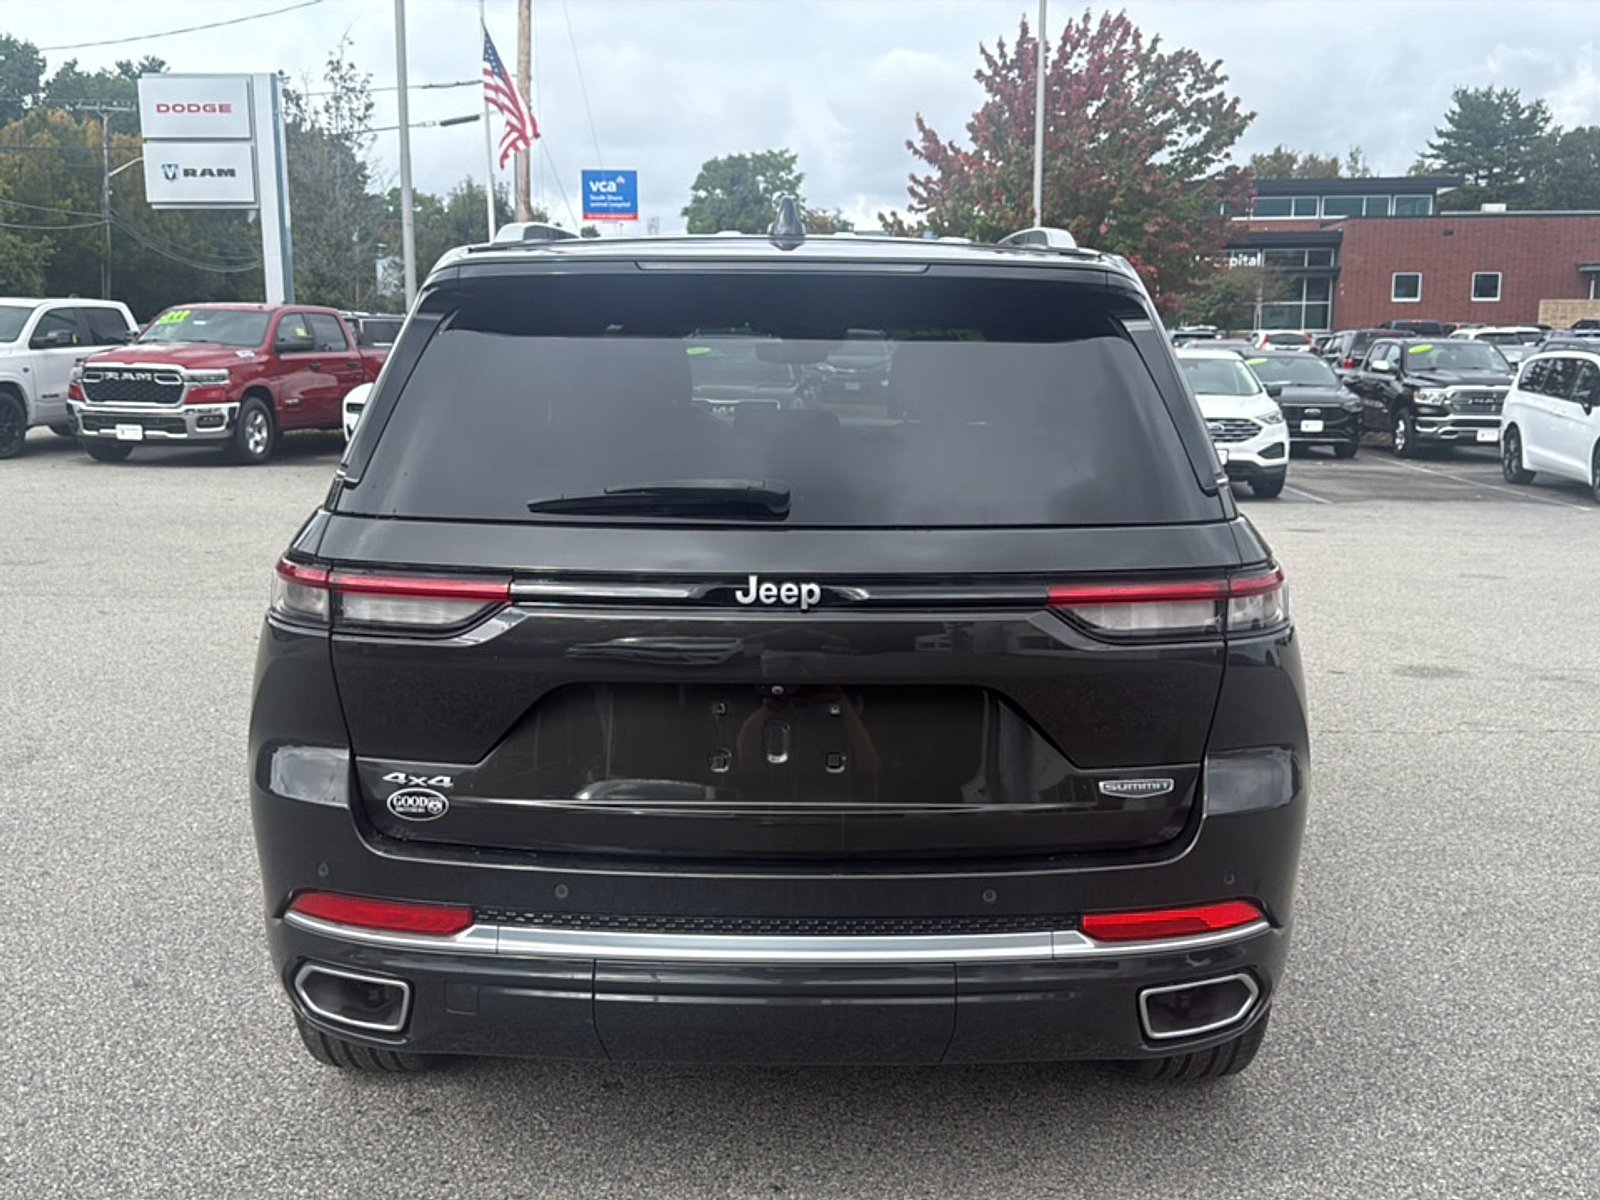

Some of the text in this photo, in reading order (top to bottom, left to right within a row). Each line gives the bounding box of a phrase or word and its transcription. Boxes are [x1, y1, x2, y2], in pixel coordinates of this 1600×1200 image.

[156, 103, 233, 114] DODGE
[183, 168, 236, 177] RAM
[589, 180, 617, 193] vca
[104, 371, 152, 382] RAM
[735, 574, 821, 610] Jeep
[382, 771, 454, 788] 4x4
[1104, 781, 1169, 791] SUMMIT
[393, 795, 428, 808] GOOD
